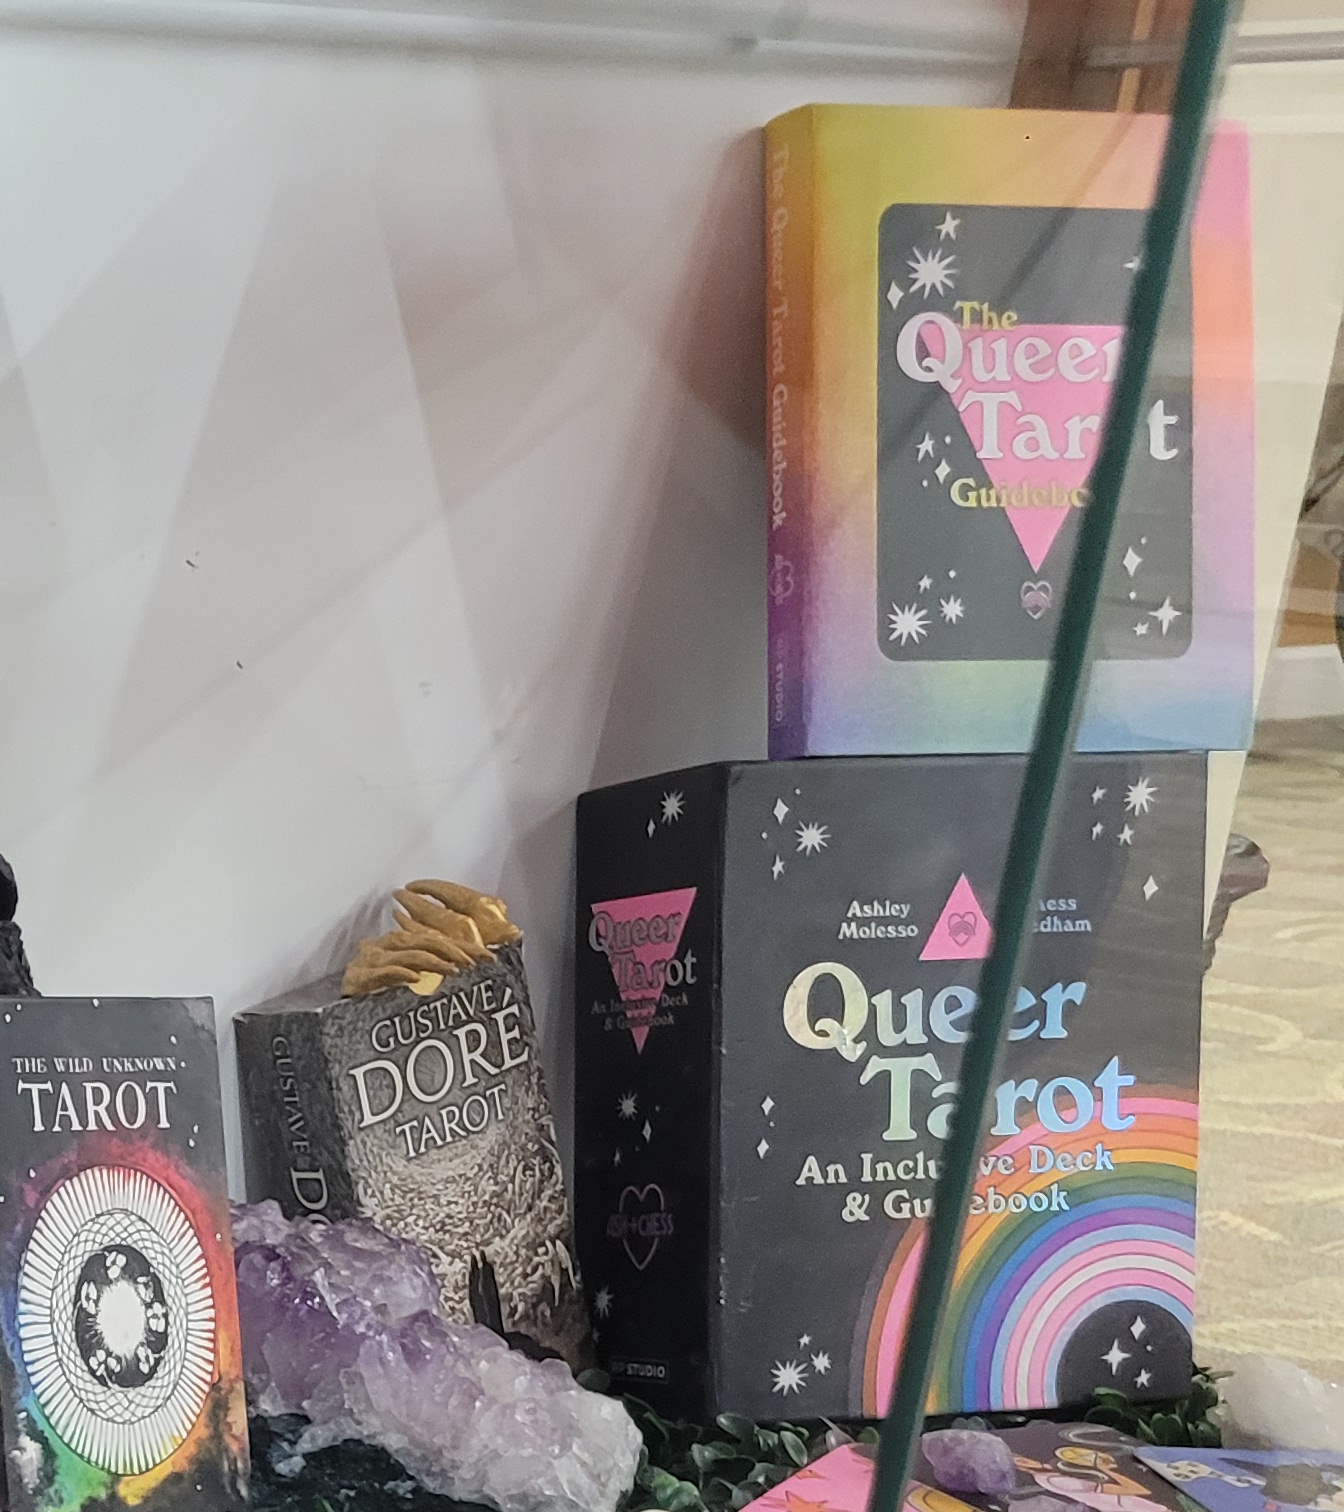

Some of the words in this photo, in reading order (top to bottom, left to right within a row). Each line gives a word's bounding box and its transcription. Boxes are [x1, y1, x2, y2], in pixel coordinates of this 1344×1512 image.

[953, 300, 1018, 331] The
[958, 390, 1179, 460] Tart
[772, 382, 789, 531] Guidebook
[838, 919, 919, 940] Molesso
[846, 899, 912, 922] Ashley
[589, 911, 682, 958] Queer
[612, 949, 697, 992] Tarot
[370, 981, 495, 1055] GUSTAVE
[13, 1056, 47, 1075] THE
[53, 1056, 94, 1074] WILD
[101, 1056, 177, 1073] UNKNOWN
[348, 987, 529, 1130] DORÉ
[17, 1079, 177, 1133] TAROT
[273, 1036, 310, 1153] GUSTAVE
[394, 1086, 508, 1158] TAROT
[795, 1155, 847, 1186] An
[1029, 1143, 1114, 1174] Deck
[842, 1191, 869, 1223] &
[884, 1183, 1069, 1219] Guebook
[627, 1363, 666, 1378] STUDIO
